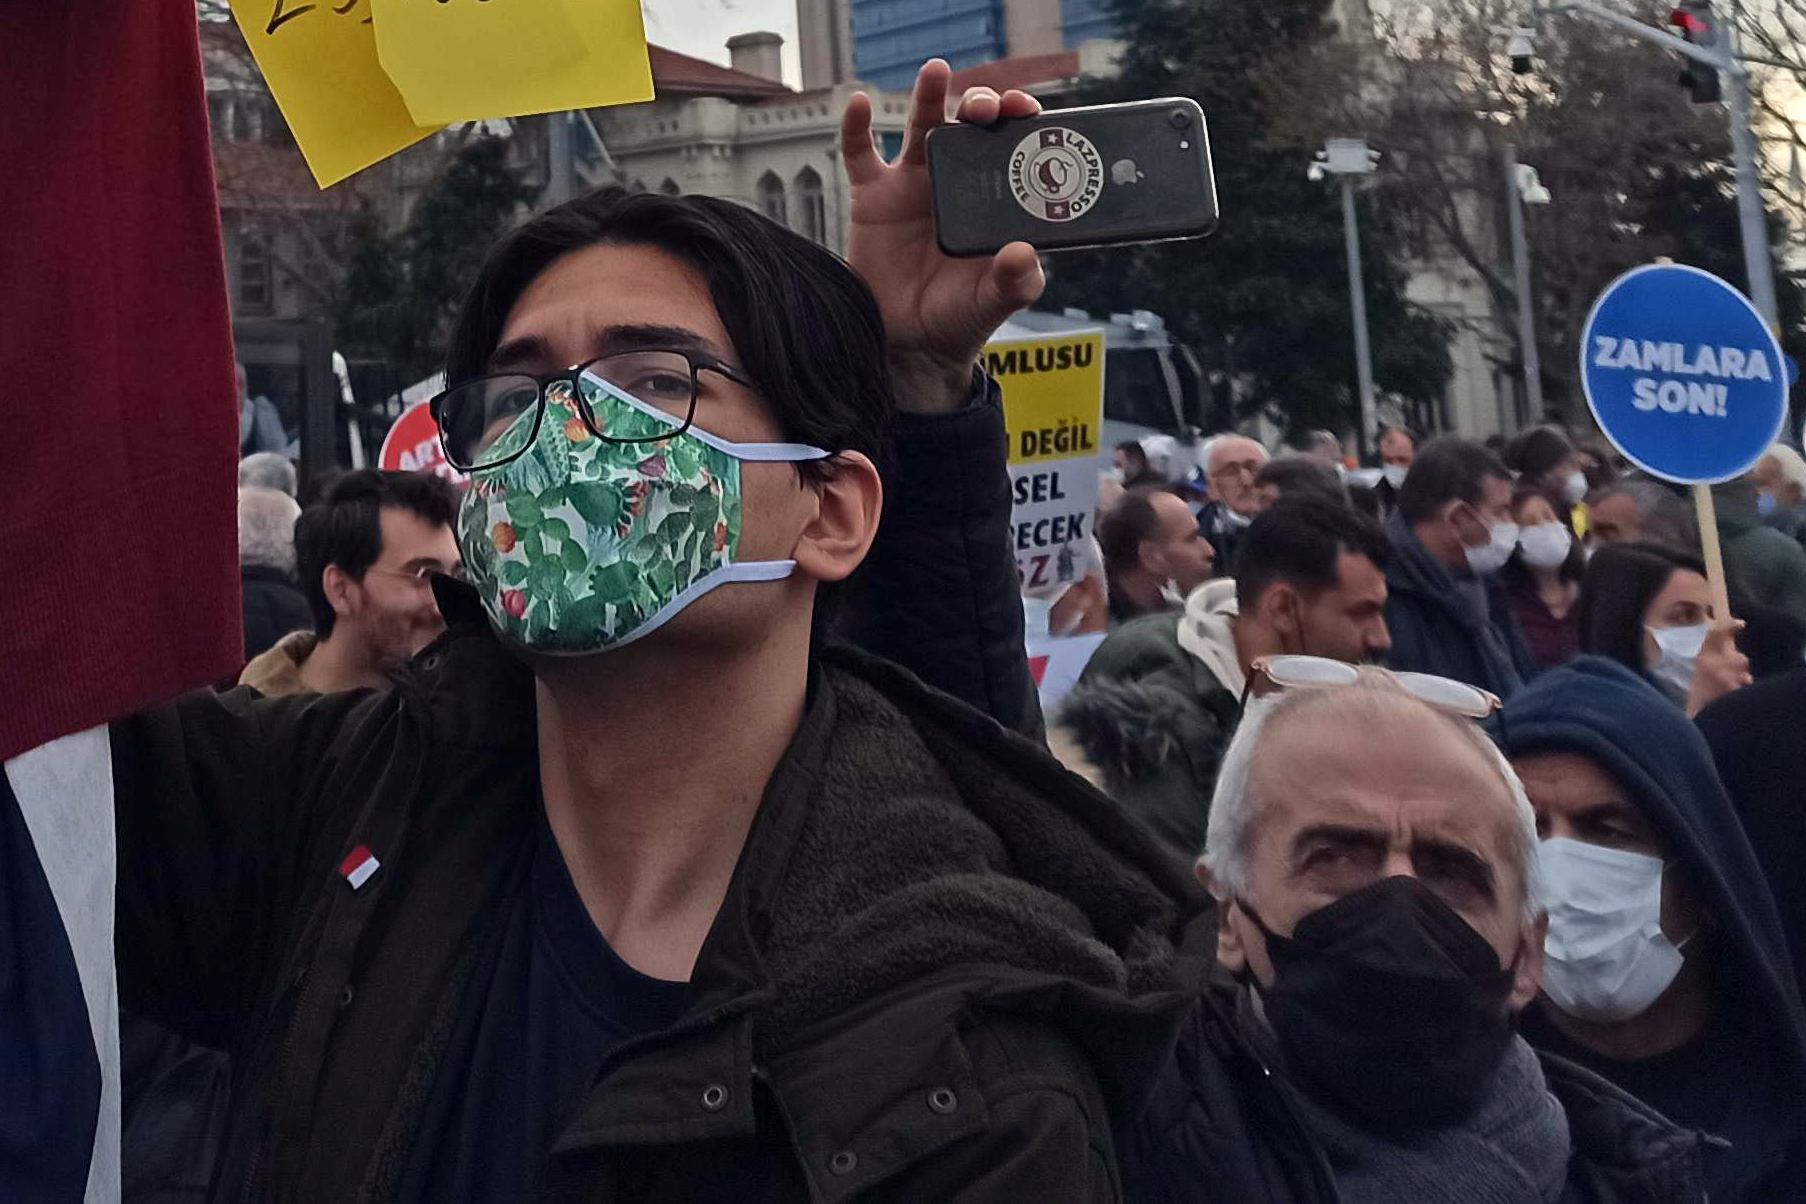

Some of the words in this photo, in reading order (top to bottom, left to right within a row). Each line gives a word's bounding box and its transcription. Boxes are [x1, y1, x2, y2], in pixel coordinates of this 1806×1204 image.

[1064, 132, 1100, 213] LAZPRESSO
[1594, 334, 1773, 383] ZAMLARA
[1630, 377, 1729, 418] SON!
[1020, 416, 1094, 459] DEĞİL
[1010, 512, 1086, 550] ECEK
